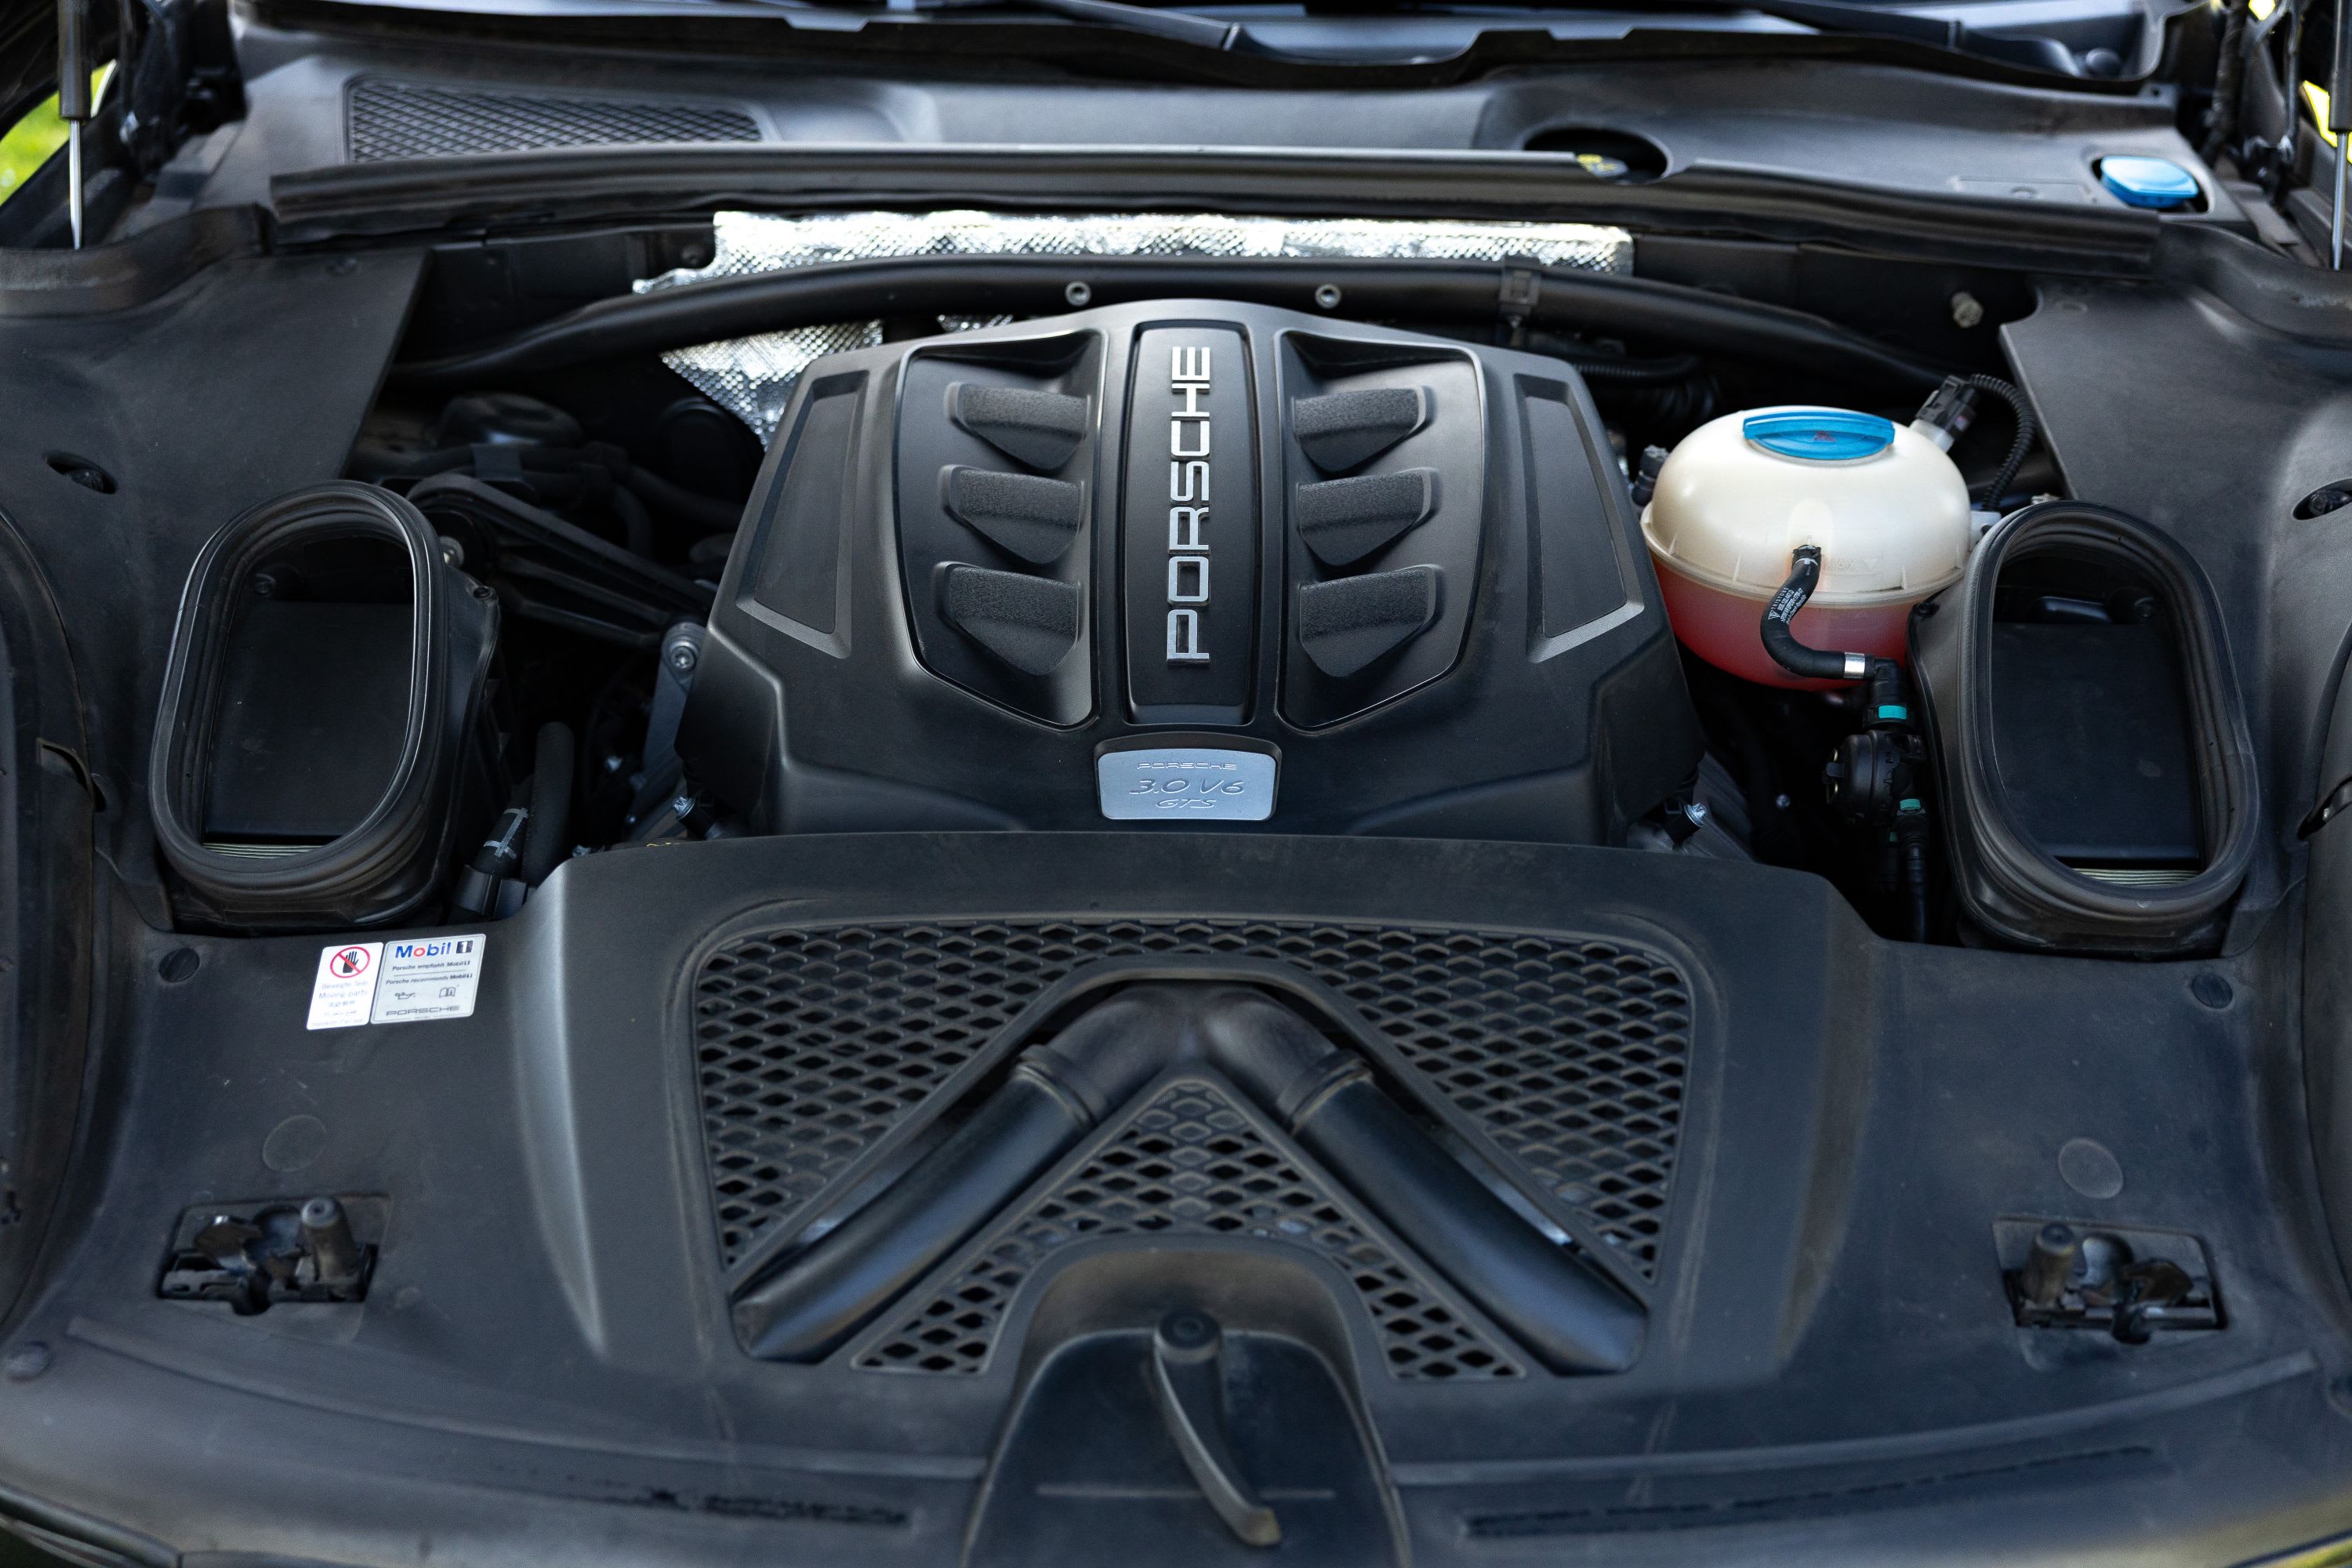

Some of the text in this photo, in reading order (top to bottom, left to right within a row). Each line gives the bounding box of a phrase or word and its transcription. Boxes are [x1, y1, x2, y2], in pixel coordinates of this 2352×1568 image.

[1167, 347, 1211, 662] PORSCHE
[1129, 779, 1245, 795] 3.0 V6
[1156, 798, 1217, 809] GTS
[395, 942, 452, 959] Mobil
[348, 989, 368, 998] parts
[386, 1005, 460, 1016] PORSCHE
